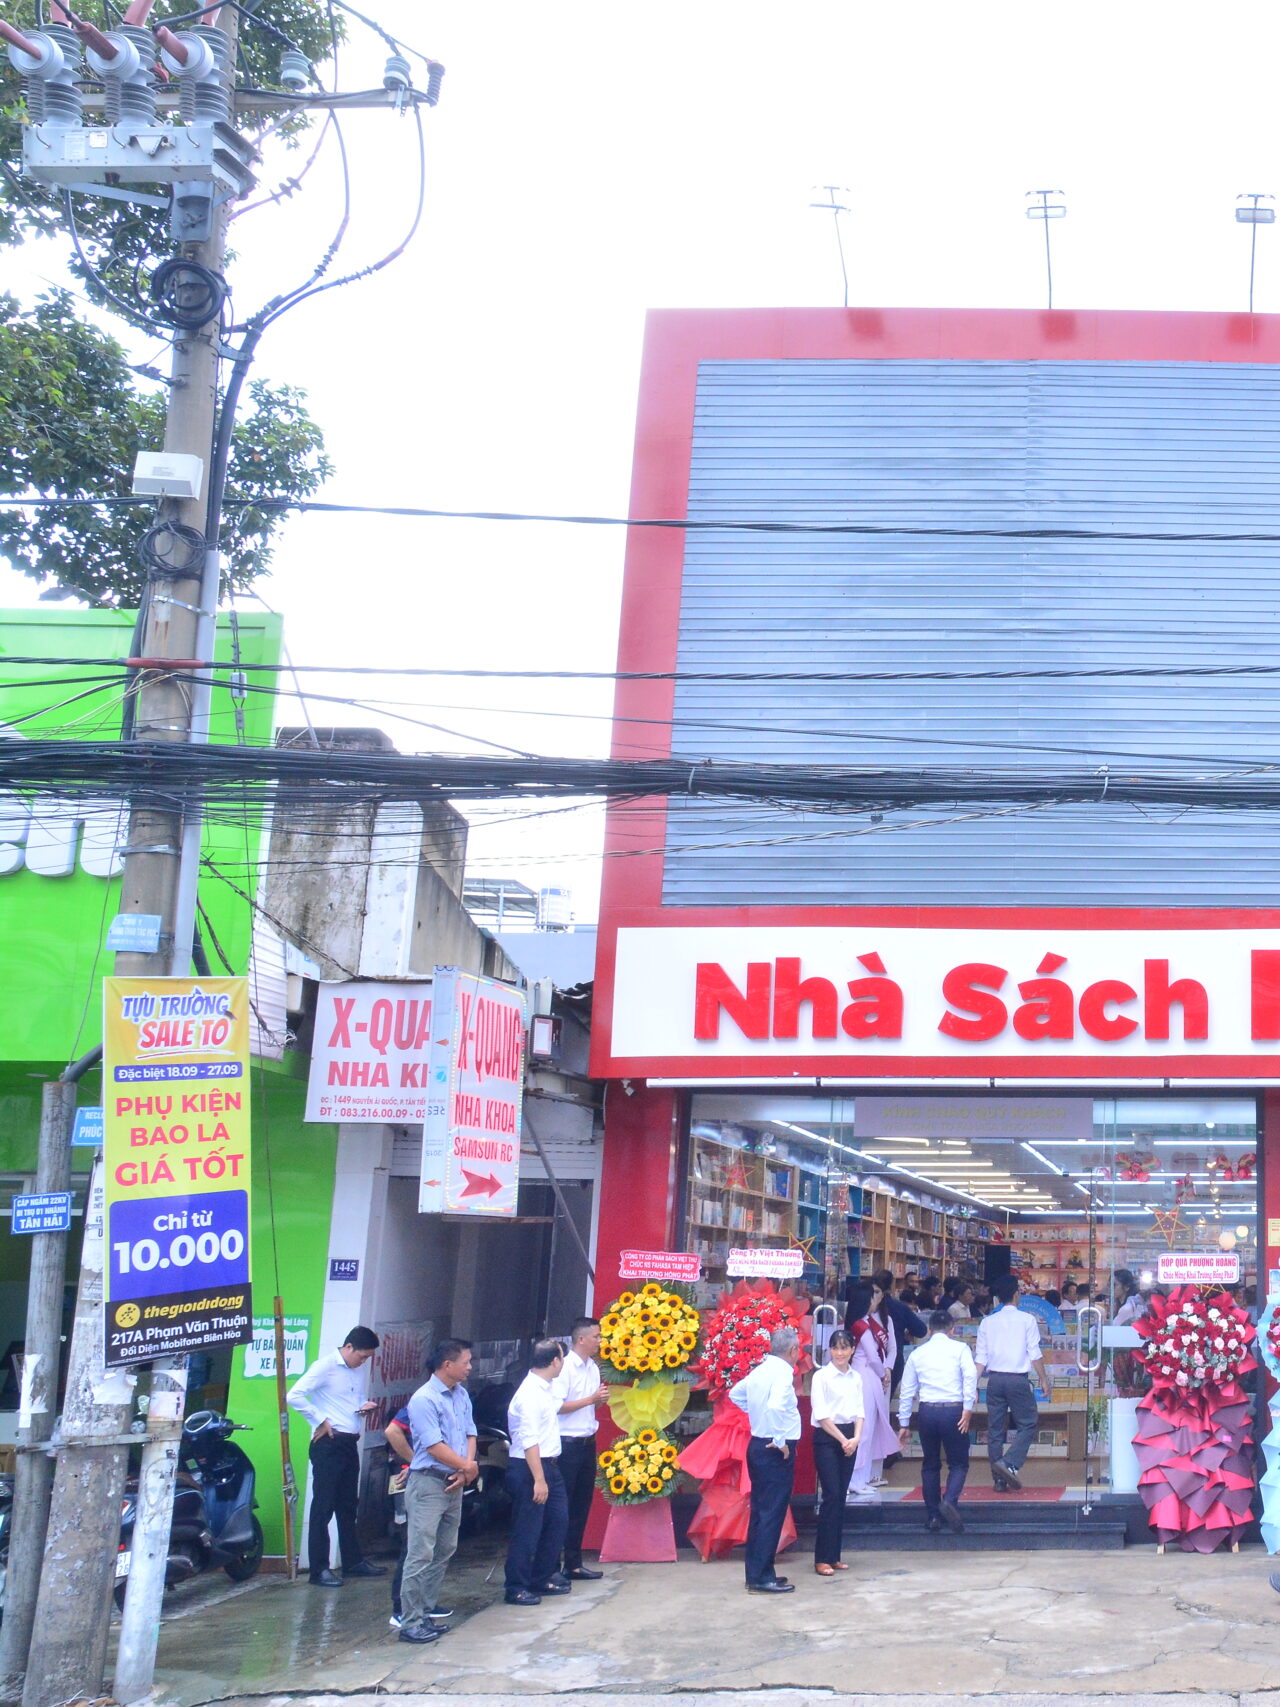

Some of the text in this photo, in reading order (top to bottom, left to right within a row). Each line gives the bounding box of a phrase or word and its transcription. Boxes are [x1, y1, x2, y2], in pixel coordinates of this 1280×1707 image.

[694, 951, 903, 1042] Nhà
[938, 951, 1208, 1042] Sách
[140, 1018, 230, 1048] SALE TO
[457, 992, 522, 1084] X-QUANG
[118, 1067, 142, 1081] Đặc
[143, 1066, 165, 1080] biệt
[167, 1065, 198, 1078] 18.09
[207, 1064, 239, 1076] 27.09
[327, 1061, 390, 1088] NHA
[116, 1087, 242, 1121] PHỤ KIỆN
[320, 1107, 332, 1117] ĐT
[340, 1108, 408, 1119] 083.216.00.09
[454, 1094, 516, 1134] NHA KHOA
[130, 1122, 231, 1147] BAO LA
[453, 1136, 513, 1163] SAMSUN RC
[114, 1146, 245, 1187] GIÁ TỐT
[20, 1217, 40, 1229] TÂN
[153, 1209, 214, 1232] Chỉ từ
[113, 1228, 245, 1274] 10.000
[730, 1249, 748, 1257] Công
[749, 1249, 757, 1257] Ty
[760, 1250, 774, 1258] Việt
[334, 1262, 357, 1272] 1445
[111, 1315, 248, 1346] 217A Phạm Văn Thuận
[120, 1330, 242, 1357] Đối Diện Mobifone Biên Hòa
[263, 1335, 275, 1351] BẢ
[260, 1357, 271, 1370] XE
